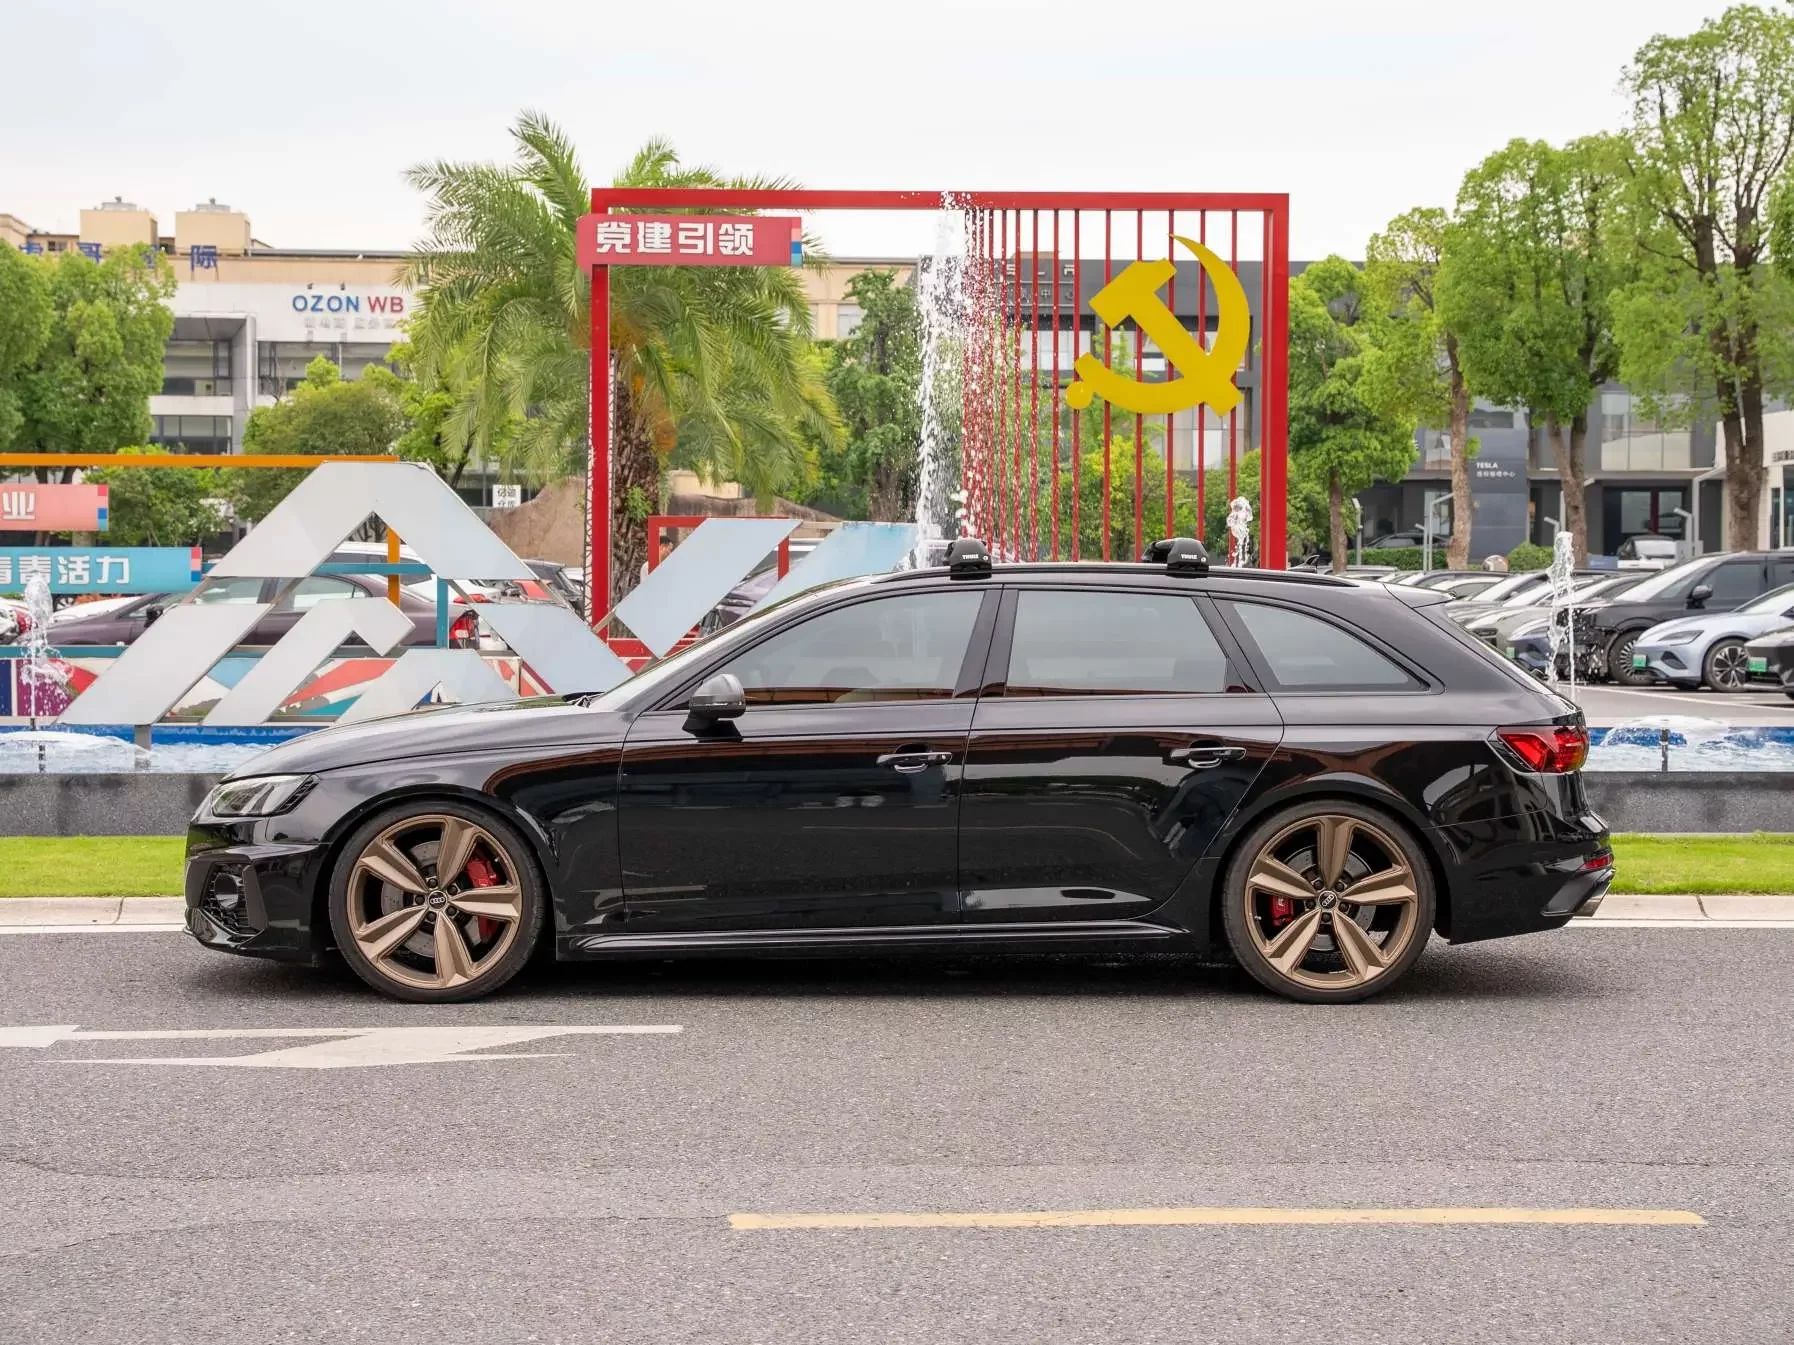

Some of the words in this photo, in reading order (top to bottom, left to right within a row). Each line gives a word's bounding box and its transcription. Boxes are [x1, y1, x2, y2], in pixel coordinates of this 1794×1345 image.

[596, 221, 754, 256] 党建引领
[292, 295, 360, 312] OZON
[367, 295, 404, 313] WB
[3, 491, 36, 520] 业
